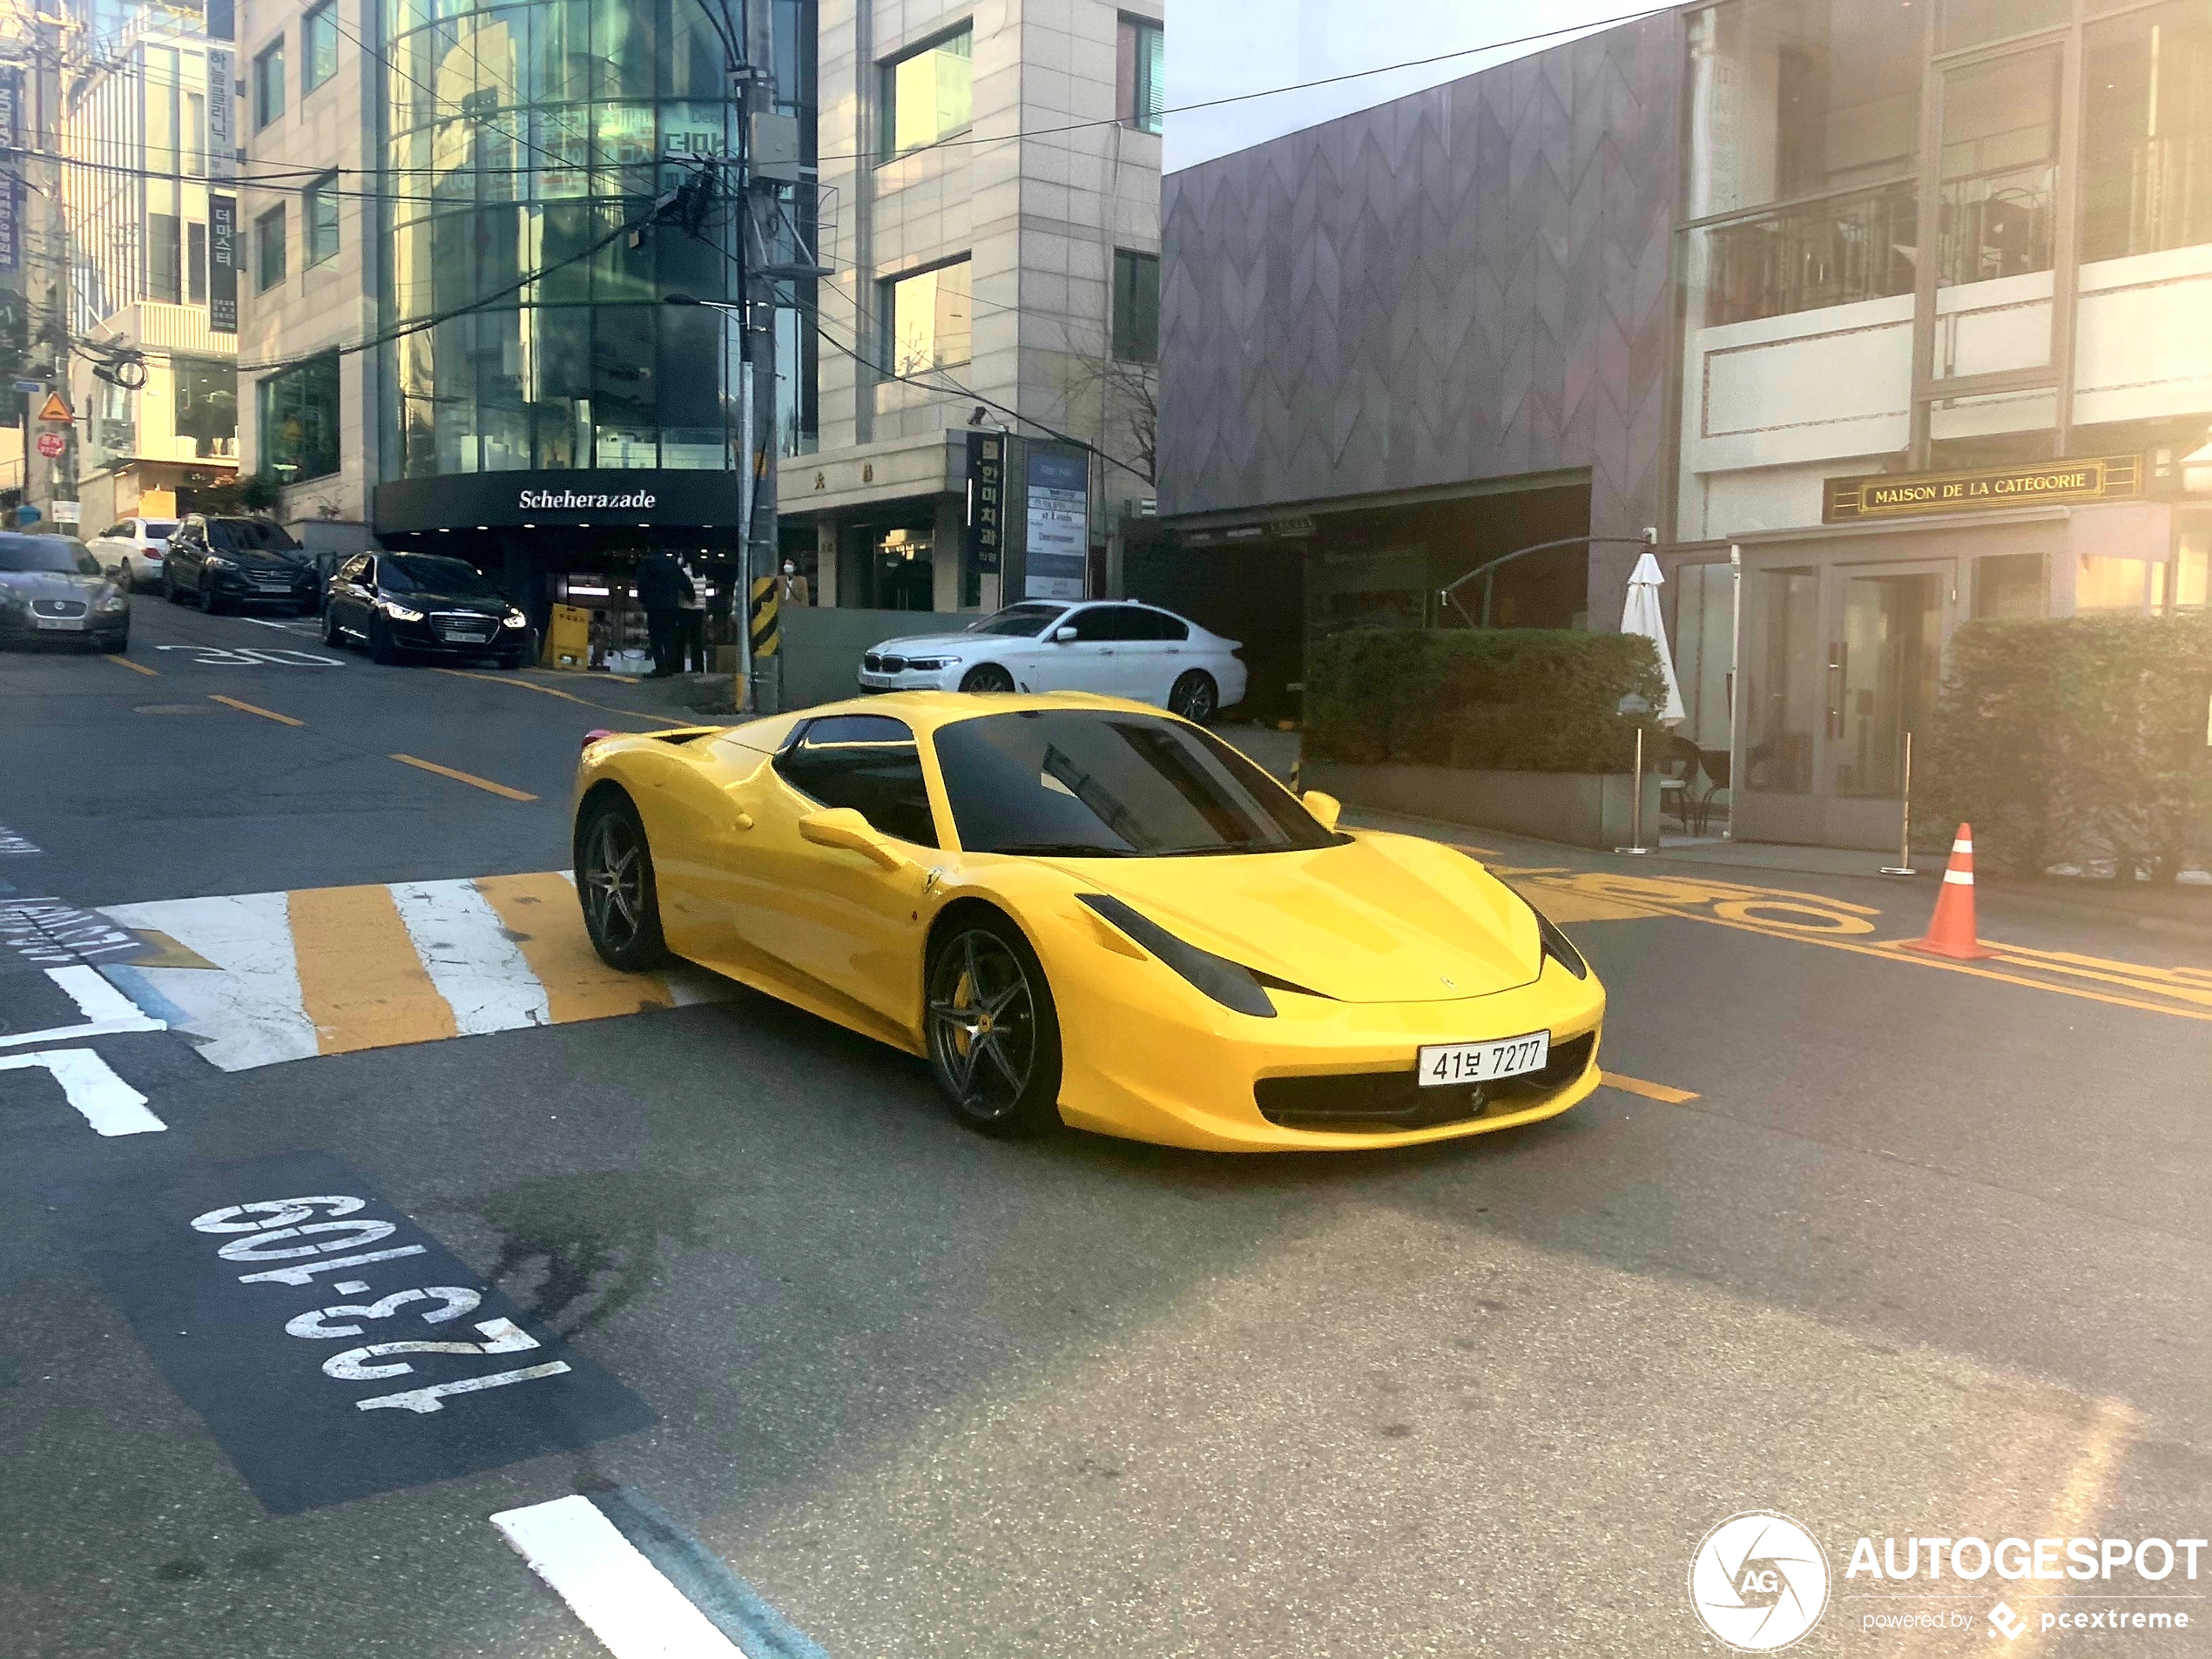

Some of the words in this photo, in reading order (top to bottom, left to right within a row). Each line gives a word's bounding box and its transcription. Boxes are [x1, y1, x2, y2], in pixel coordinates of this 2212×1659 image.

[215, 208, 233, 266] 더마스터
[519, 489, 656, 509] Scheherazade
[1875, 486, 1936, 503] MAISON
[1943, 483, 1964, 498] DE
[1970, 482, 1989, 496] LA
[156, 645, 347, 666] 30
[1433, 1051, 1480, 1080] 41보
[1493, 1040, 1541, 1075] 7277
[191, 1195, 572, 1413] 123-109
